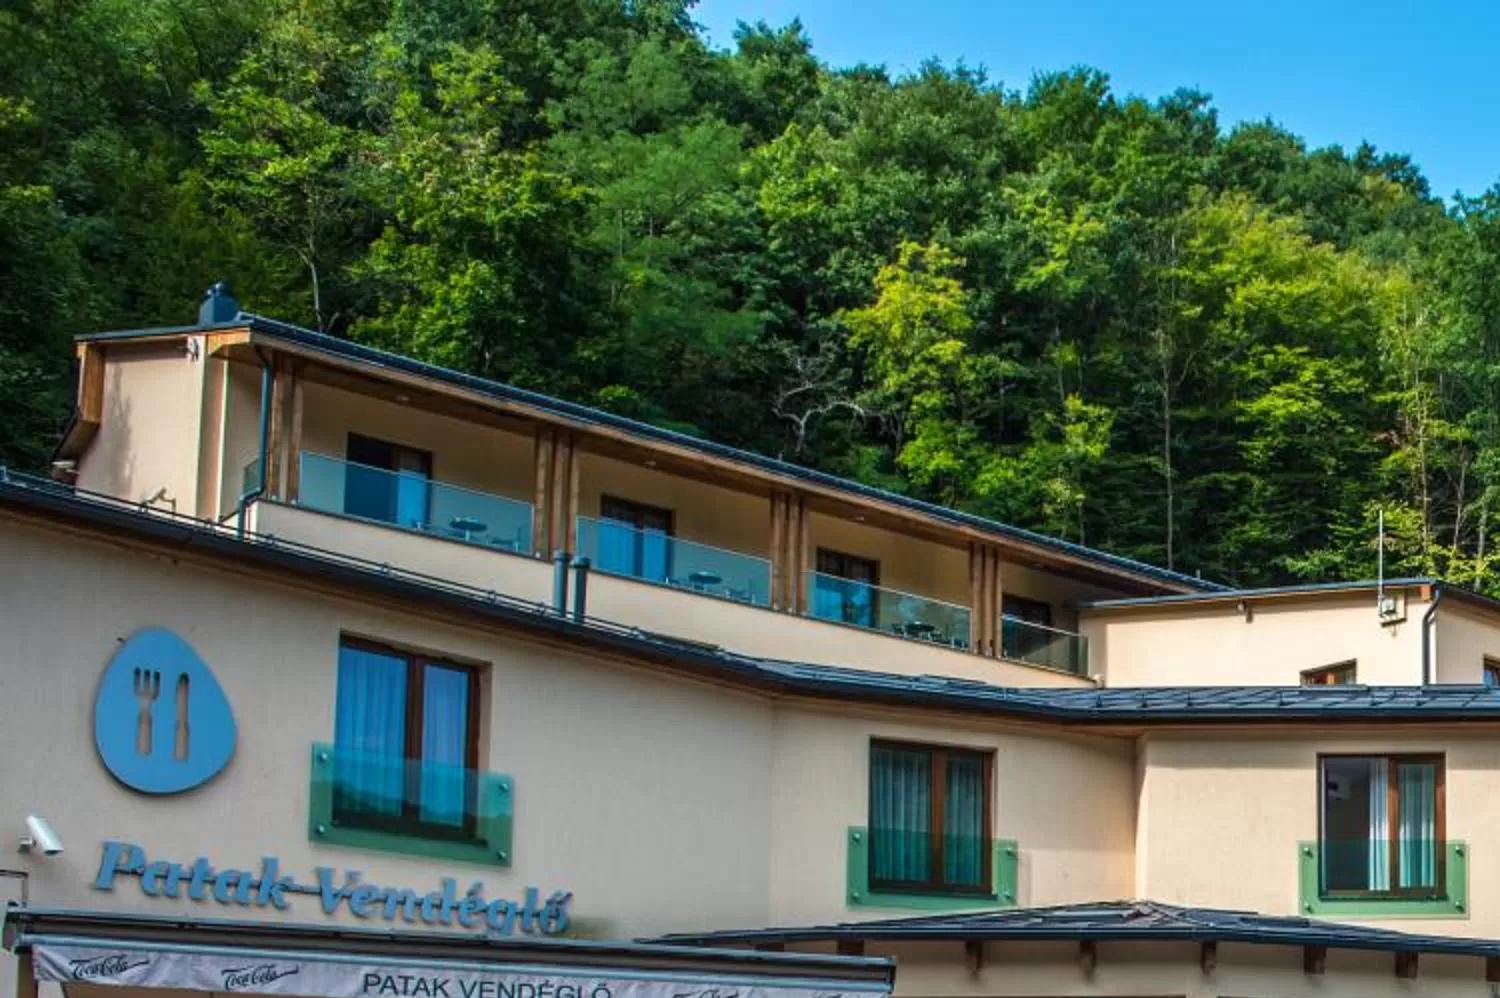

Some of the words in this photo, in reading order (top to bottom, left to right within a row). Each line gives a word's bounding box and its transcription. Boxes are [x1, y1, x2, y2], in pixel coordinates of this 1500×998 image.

[94, 840, 291, 910] Patak
[313, 866, 572, 936] Vendéglő
[363, 973, 450, 998] PATAK
